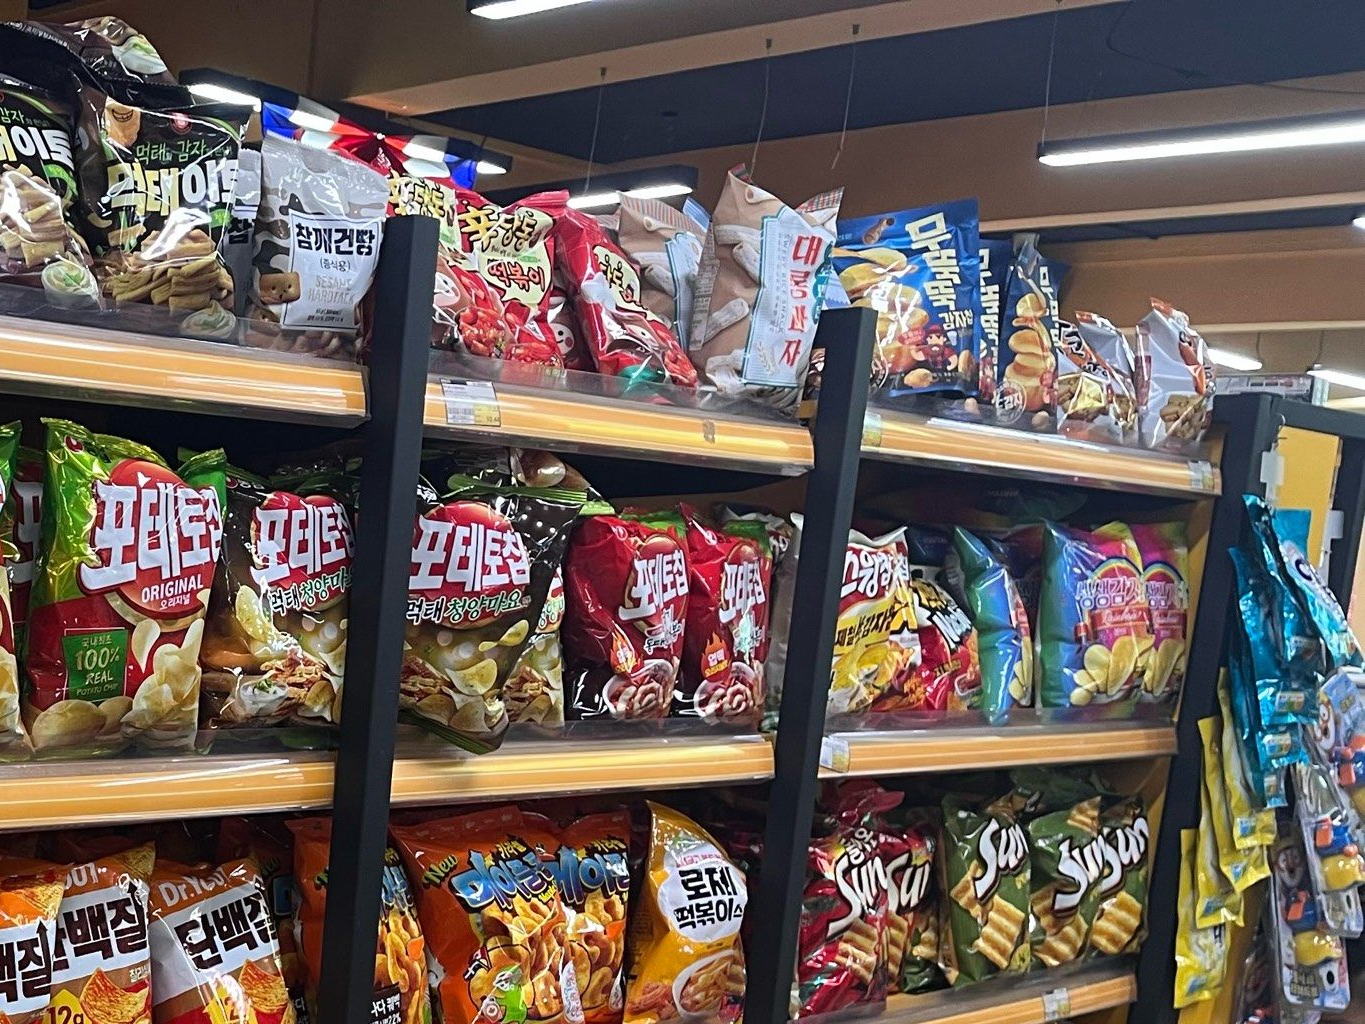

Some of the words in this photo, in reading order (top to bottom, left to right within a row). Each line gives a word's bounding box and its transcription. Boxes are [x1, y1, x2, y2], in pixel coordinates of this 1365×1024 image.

[295, 222, 376, 256] 참깨건빵
[408, 515, 532, 592] 포테토칩
[140, 572, 205, 604] ORIGINAL
[159, 593, 192, 611] 오리지널
[618, 549, 689, 622] 포테토칩
[406, 597, 446, 625] 먹태
[446, 589, 520, 623] 청양마요
[73, 645, 120, 672] 100%
[85, 670, 114, 684] REAL
